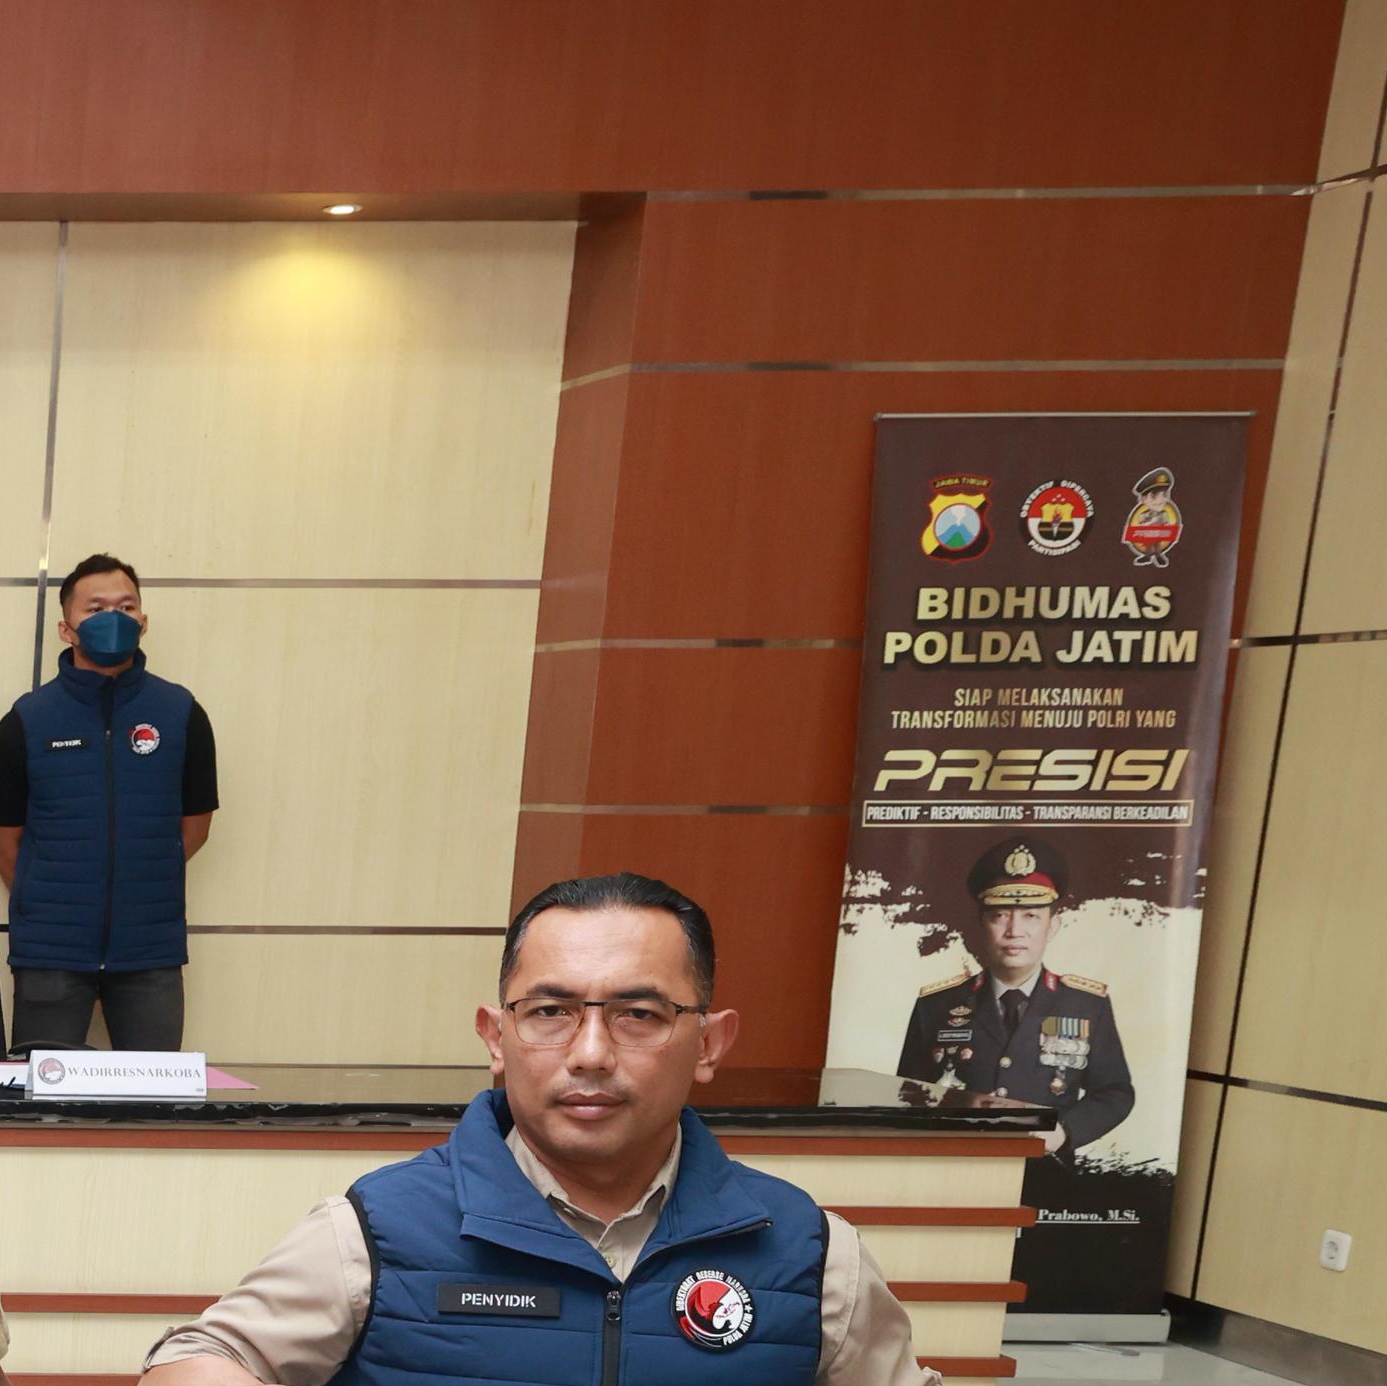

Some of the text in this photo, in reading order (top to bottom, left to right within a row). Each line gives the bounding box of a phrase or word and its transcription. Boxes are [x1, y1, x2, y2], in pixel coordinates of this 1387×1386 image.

[917, 585, 1172, 620] BIDHUMAS
[883, 630, 1198, 664] POLDA JATIM
[954, 688, 1124, 706] SIAP MELAKSANAKAN
[891, 710, 1177, 728] TRANSFORMASI MENUJU POLRI YANG
[873, 749, 1189, 791] PRESISI
[867, 806, 1188, 820] PREDIKTIF RESPONSIBILITAS TRANSPARANSI BERKEADILAN
[68, 1065, 201, 1078] WADIRRESNARKOBA
[461, 1292, 536, 1308] PENYIDIK
